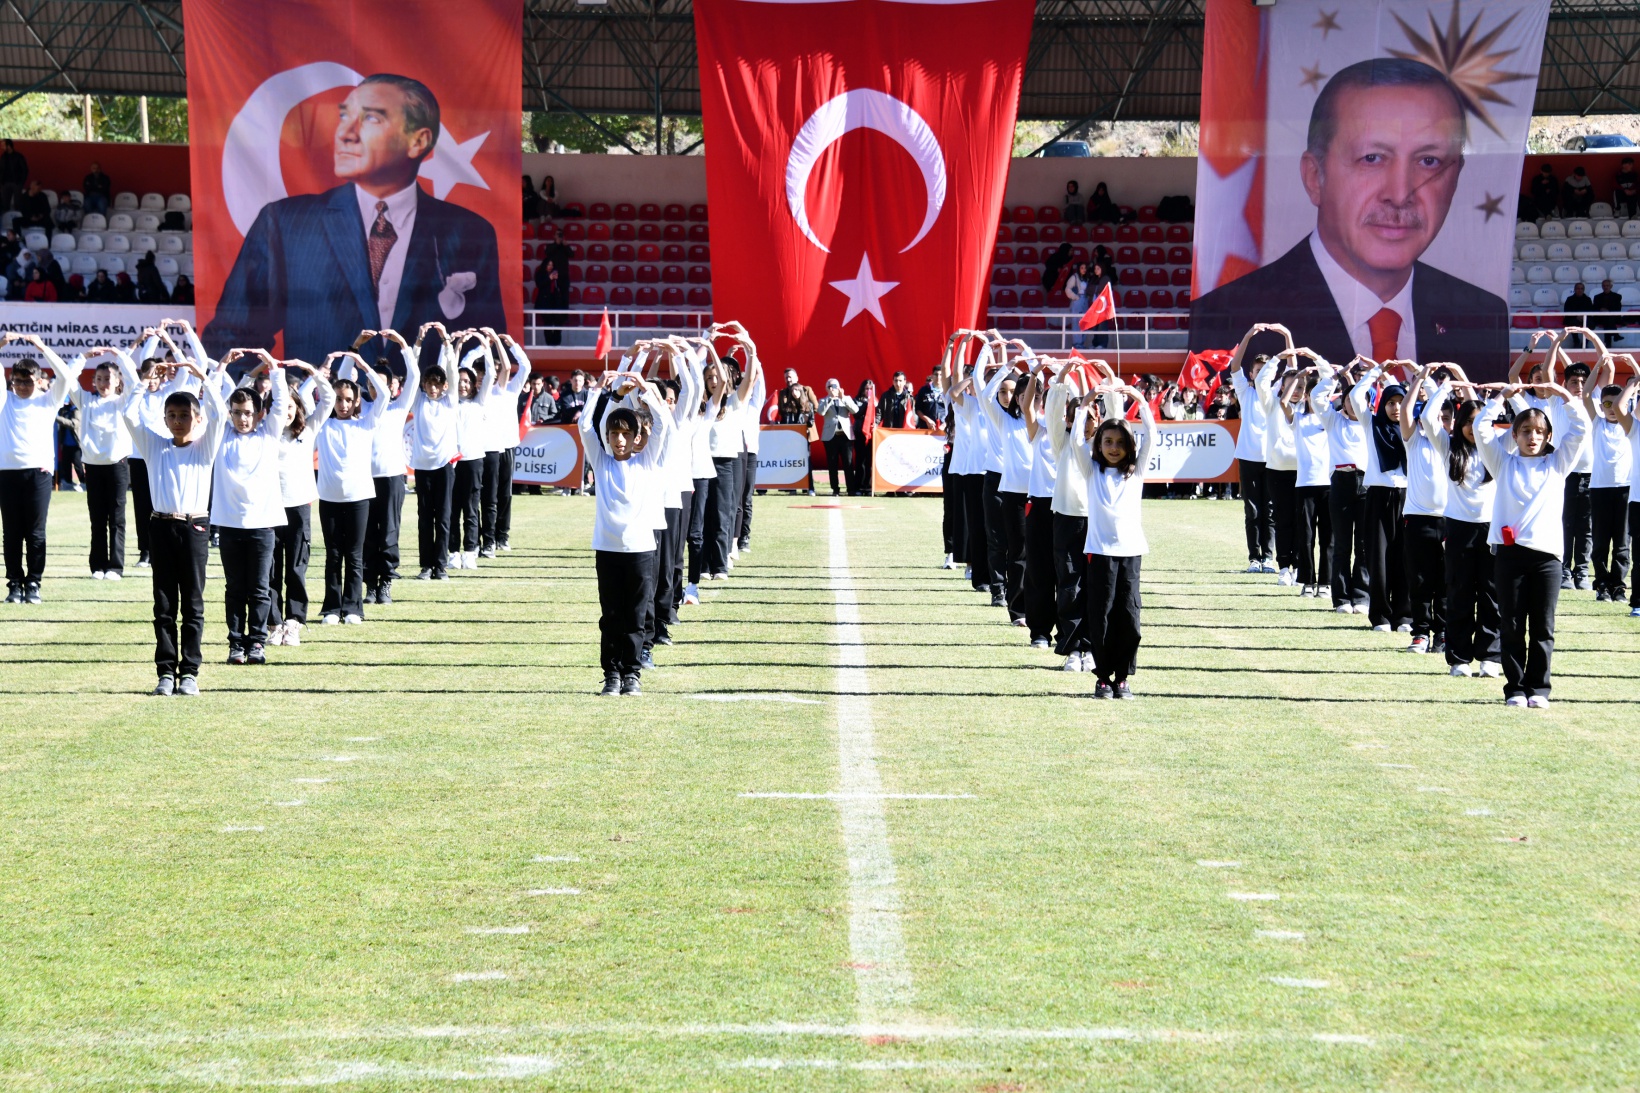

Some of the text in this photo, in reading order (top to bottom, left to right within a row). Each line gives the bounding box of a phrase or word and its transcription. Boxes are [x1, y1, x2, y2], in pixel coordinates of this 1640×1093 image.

[57, 321, 99, 334] MİRAS
[103, 325, 137, 334] ASLA
[524, 461, 556, 474] LİSESİ
[780, 459, 805, 467] LİSESİ
